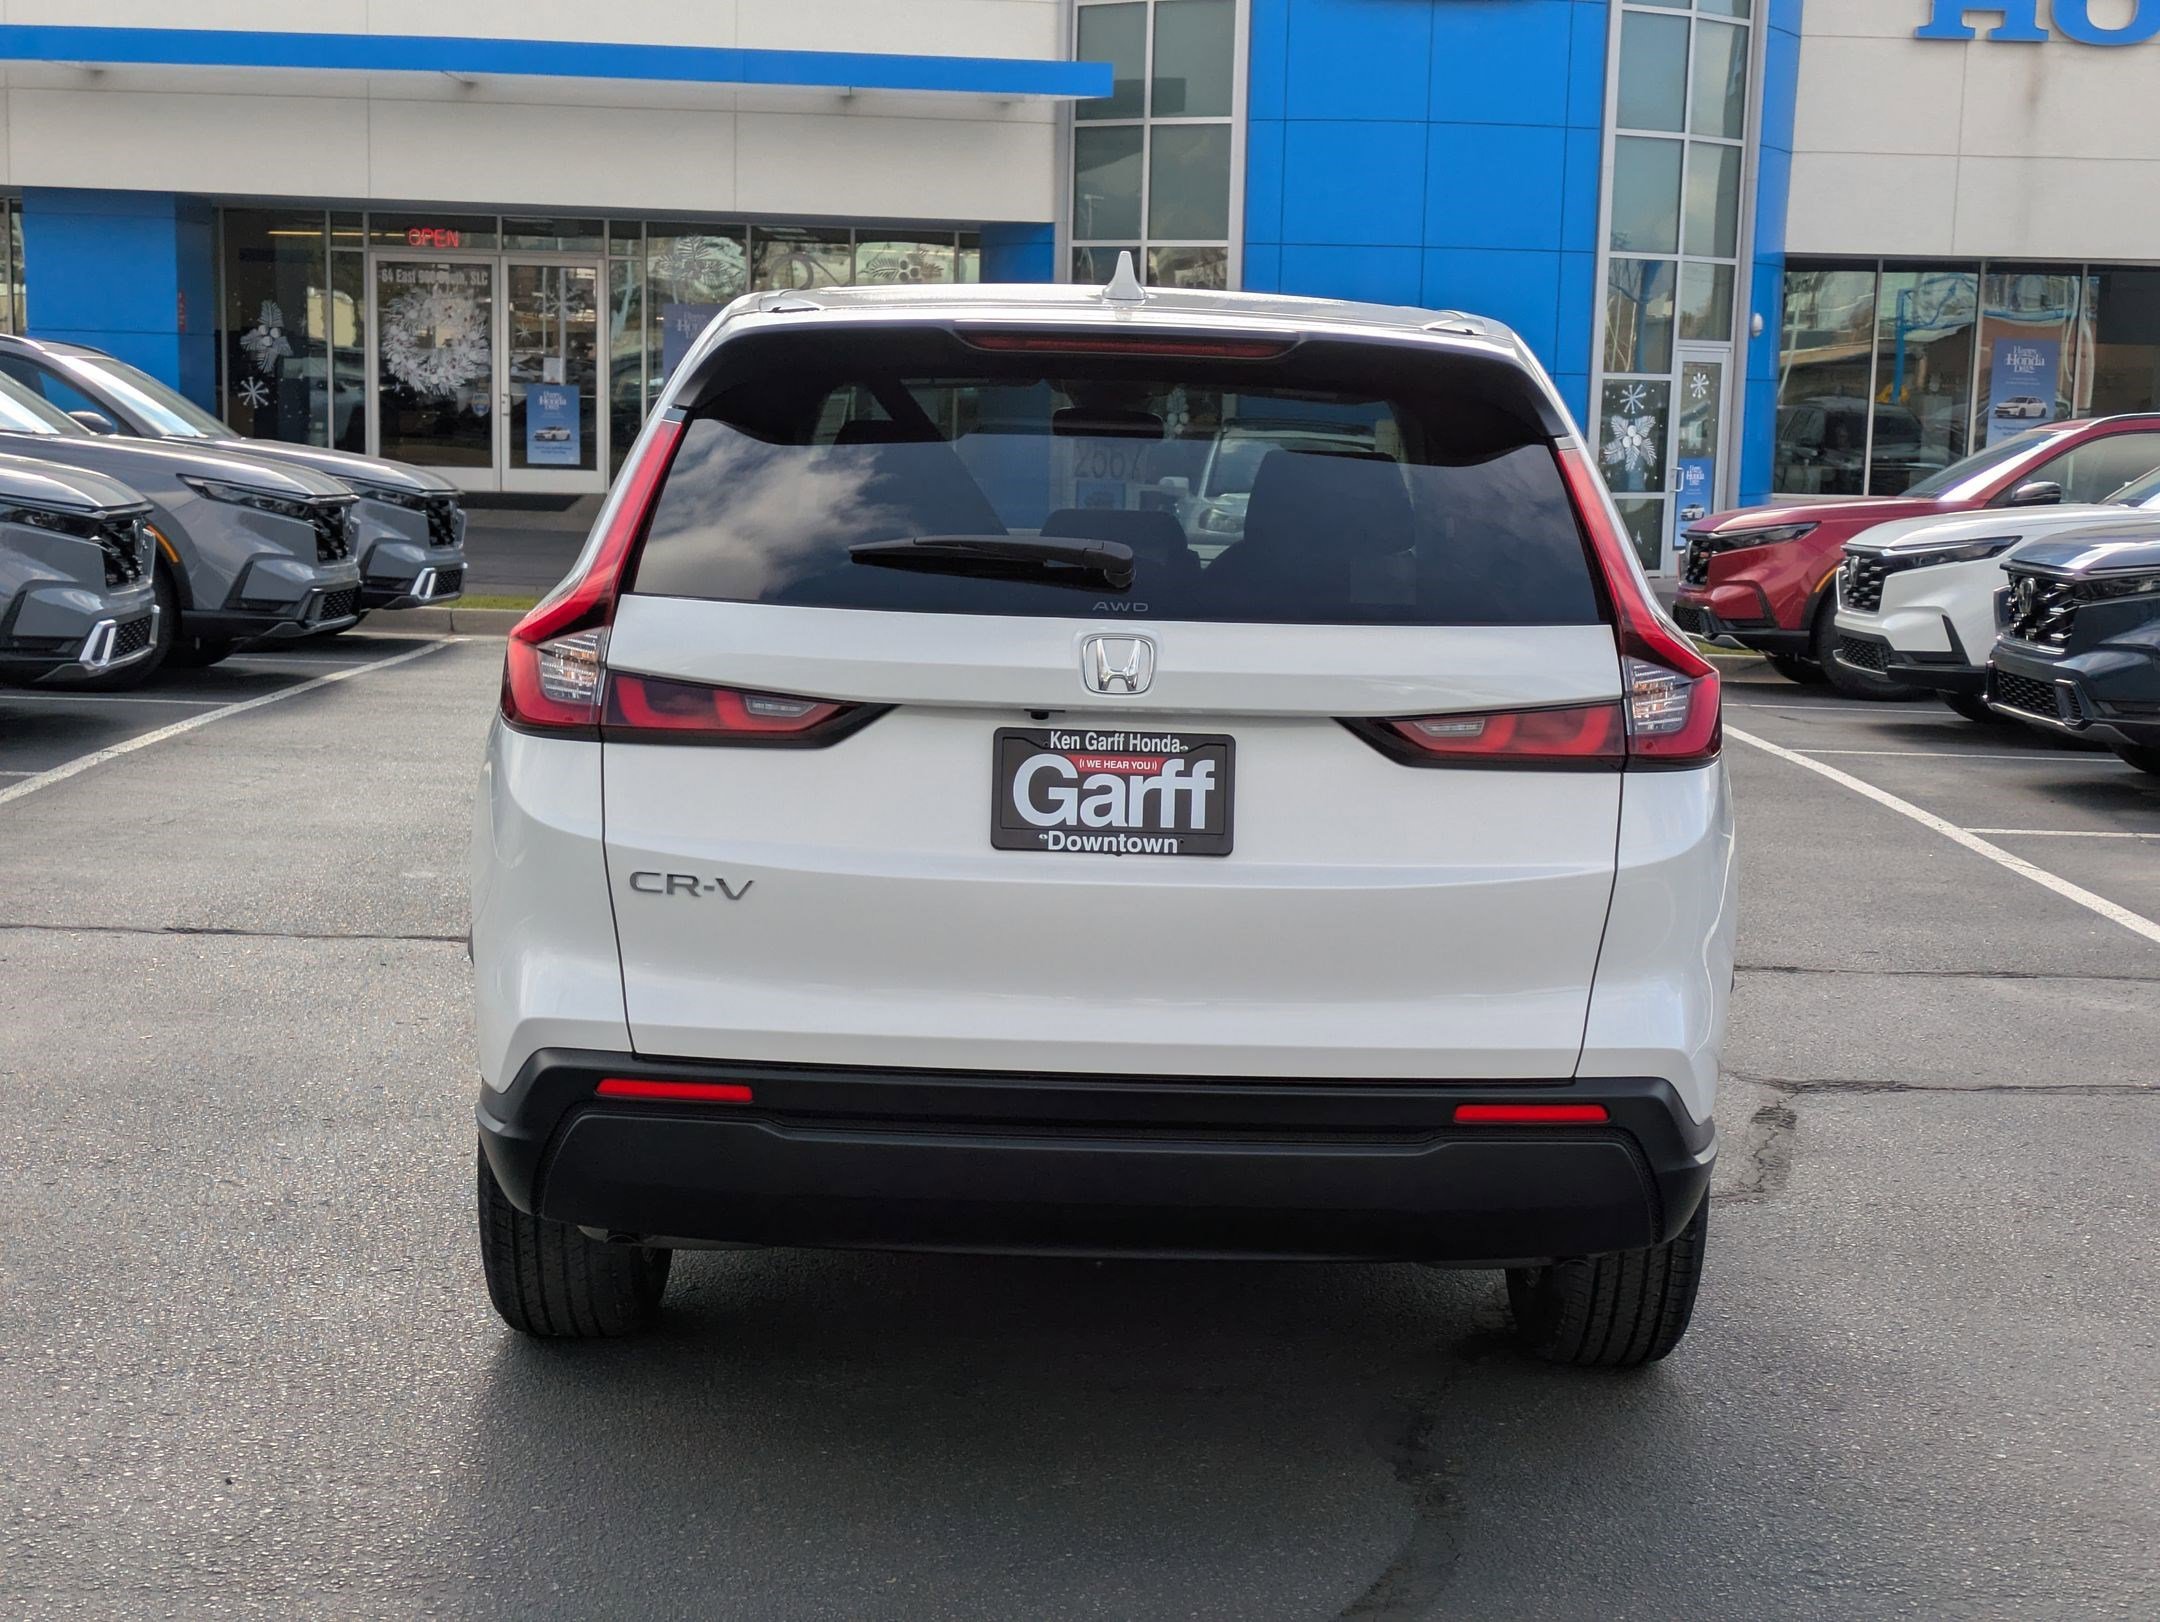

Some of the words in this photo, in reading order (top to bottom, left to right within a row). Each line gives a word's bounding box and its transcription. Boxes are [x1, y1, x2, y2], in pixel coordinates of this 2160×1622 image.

[409, 228, 459, 248] OPEN
[396, 269, 416, 284] East
[470, 271, 488, 286] SLC
[2006, 353, 2045, 366] Honda
[1092, 601, 1149, 612] AWD
[1050, 731, 1080, 750] Ken
[1085, 732, 1126, 751] Garff
[1129, 733, 1180, 753] Honda
[1086, 760, 1102, 769] WE
[1103, 760, 1130, 770] HEAR
[1131, 761, 1151, 770] YOU
[1013, 753, 1216, 829] Garff
[1047, 830, 1178, 854] Downtown
[629, 871, 755, 900] CR-V
